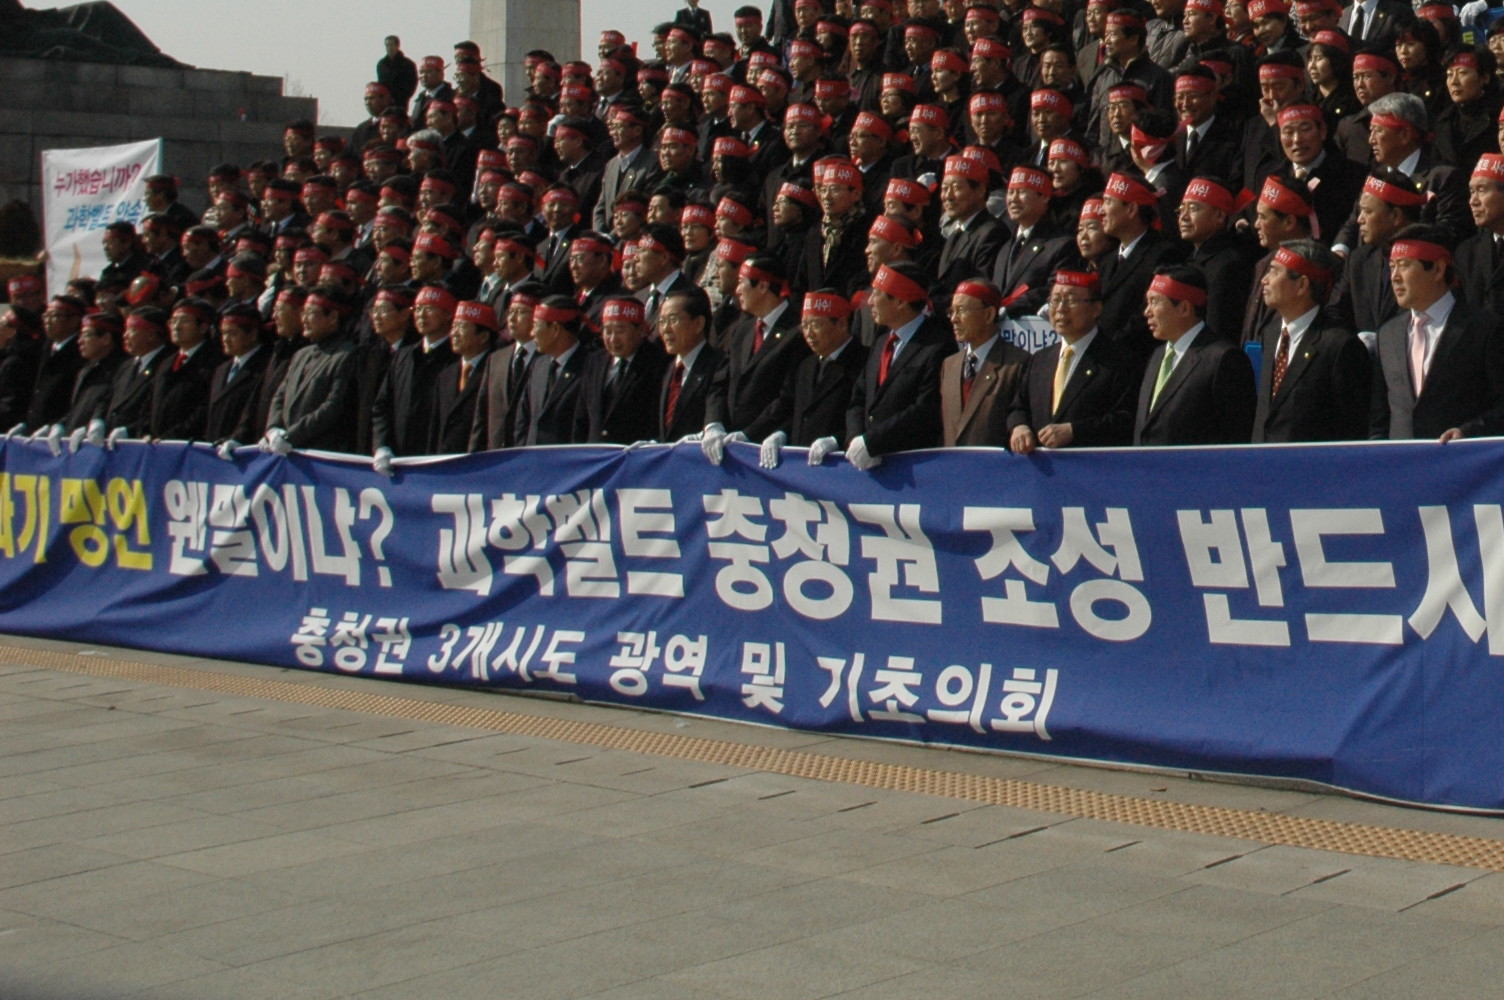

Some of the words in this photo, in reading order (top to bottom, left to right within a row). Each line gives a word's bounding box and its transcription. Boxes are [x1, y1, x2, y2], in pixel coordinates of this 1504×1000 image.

[60, 477, 153, 571] 망언
[163, 479, 394, 587] 웬말이냐?
[431, 488, 685, 598] 과학벨트
[702, 488, 943, 625] 충청권
[962, 506, 1153, 642] 조성
[291, 607, 412, 675] 충청권
[427, 621, 586, 685] 3개시도
[609, 630, 708, 700] 광역
[740, 641, 787, 714] 및
[816, 652, 1060, 741] 기초의회
